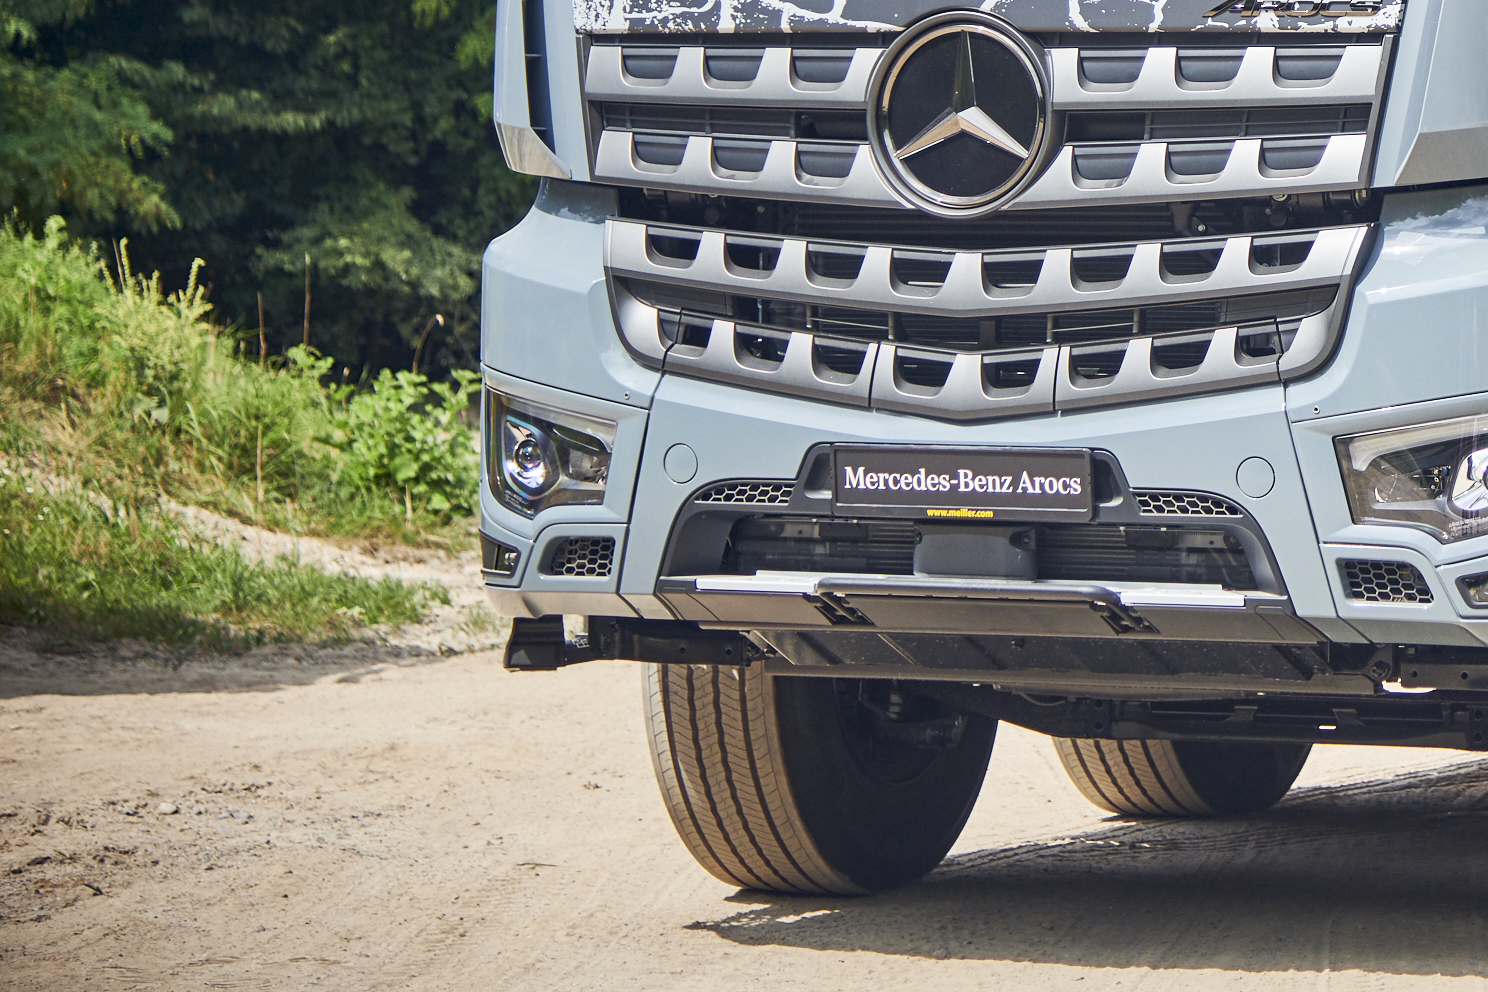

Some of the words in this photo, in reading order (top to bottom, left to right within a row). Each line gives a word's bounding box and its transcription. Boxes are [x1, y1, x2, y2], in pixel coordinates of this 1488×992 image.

[844, 466, 1013, 494] Mercedes-Benz
[1017, 470, 1082, 496] Arocs
[926, 508, 994, 518] www.meiller.com
